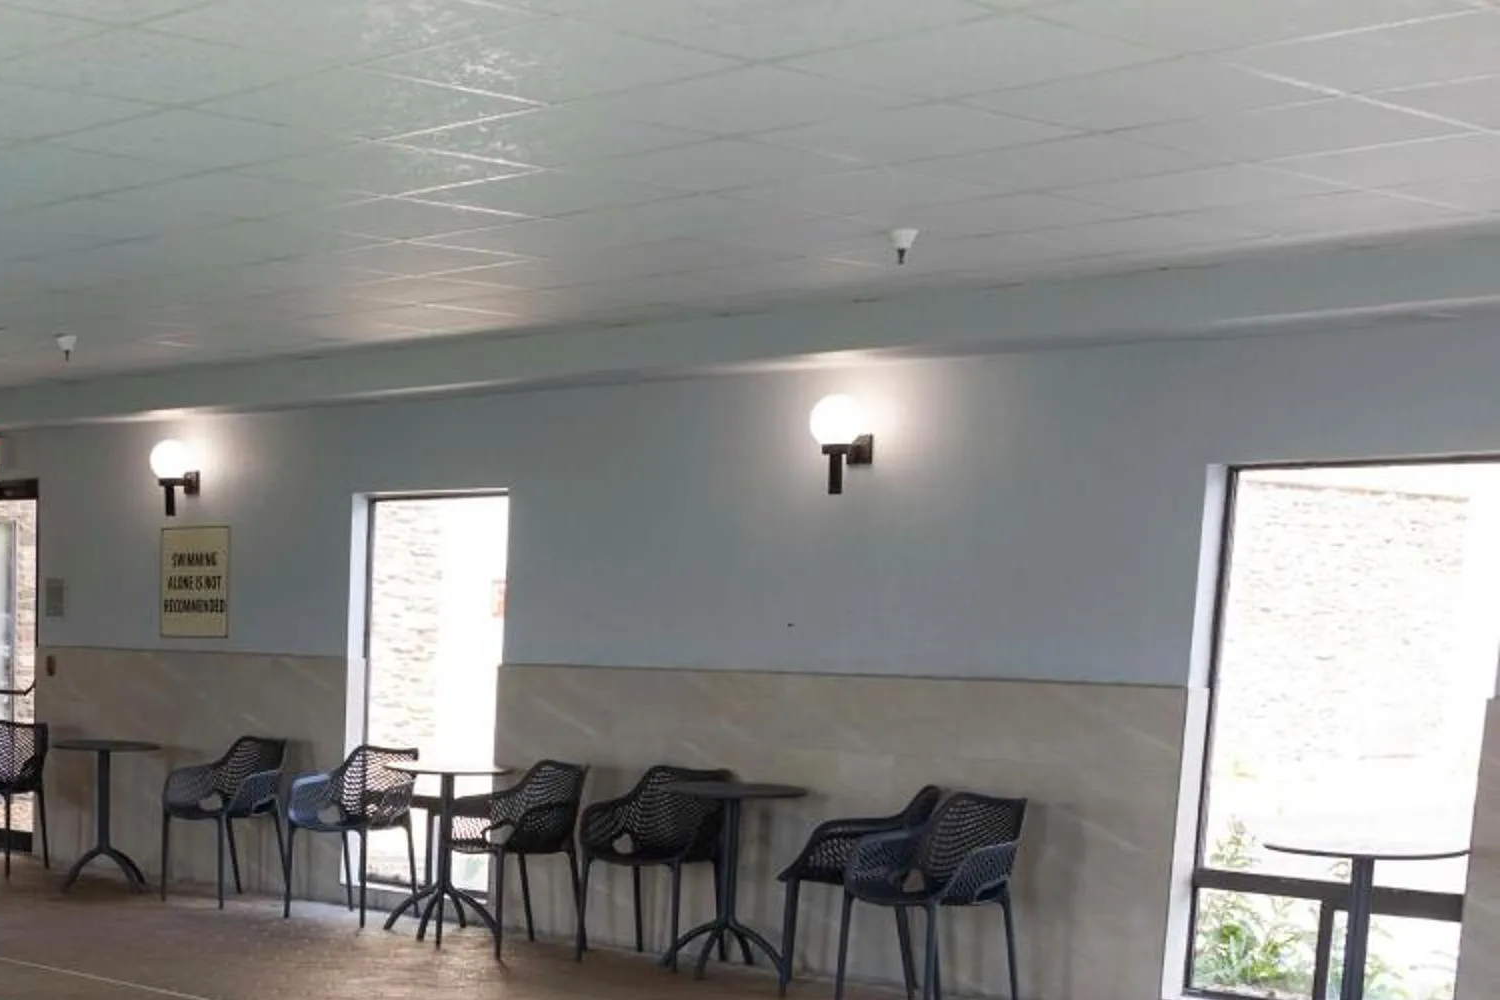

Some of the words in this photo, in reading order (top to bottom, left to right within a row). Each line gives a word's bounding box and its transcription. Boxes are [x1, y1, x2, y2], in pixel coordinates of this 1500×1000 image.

[171, 551, 218, 568] SWIMMING
[167, 575, 193, 591] ALONE
[205, 575, 222, 591] NOT
[163, 598, 226, 614] RECOMMENDED
